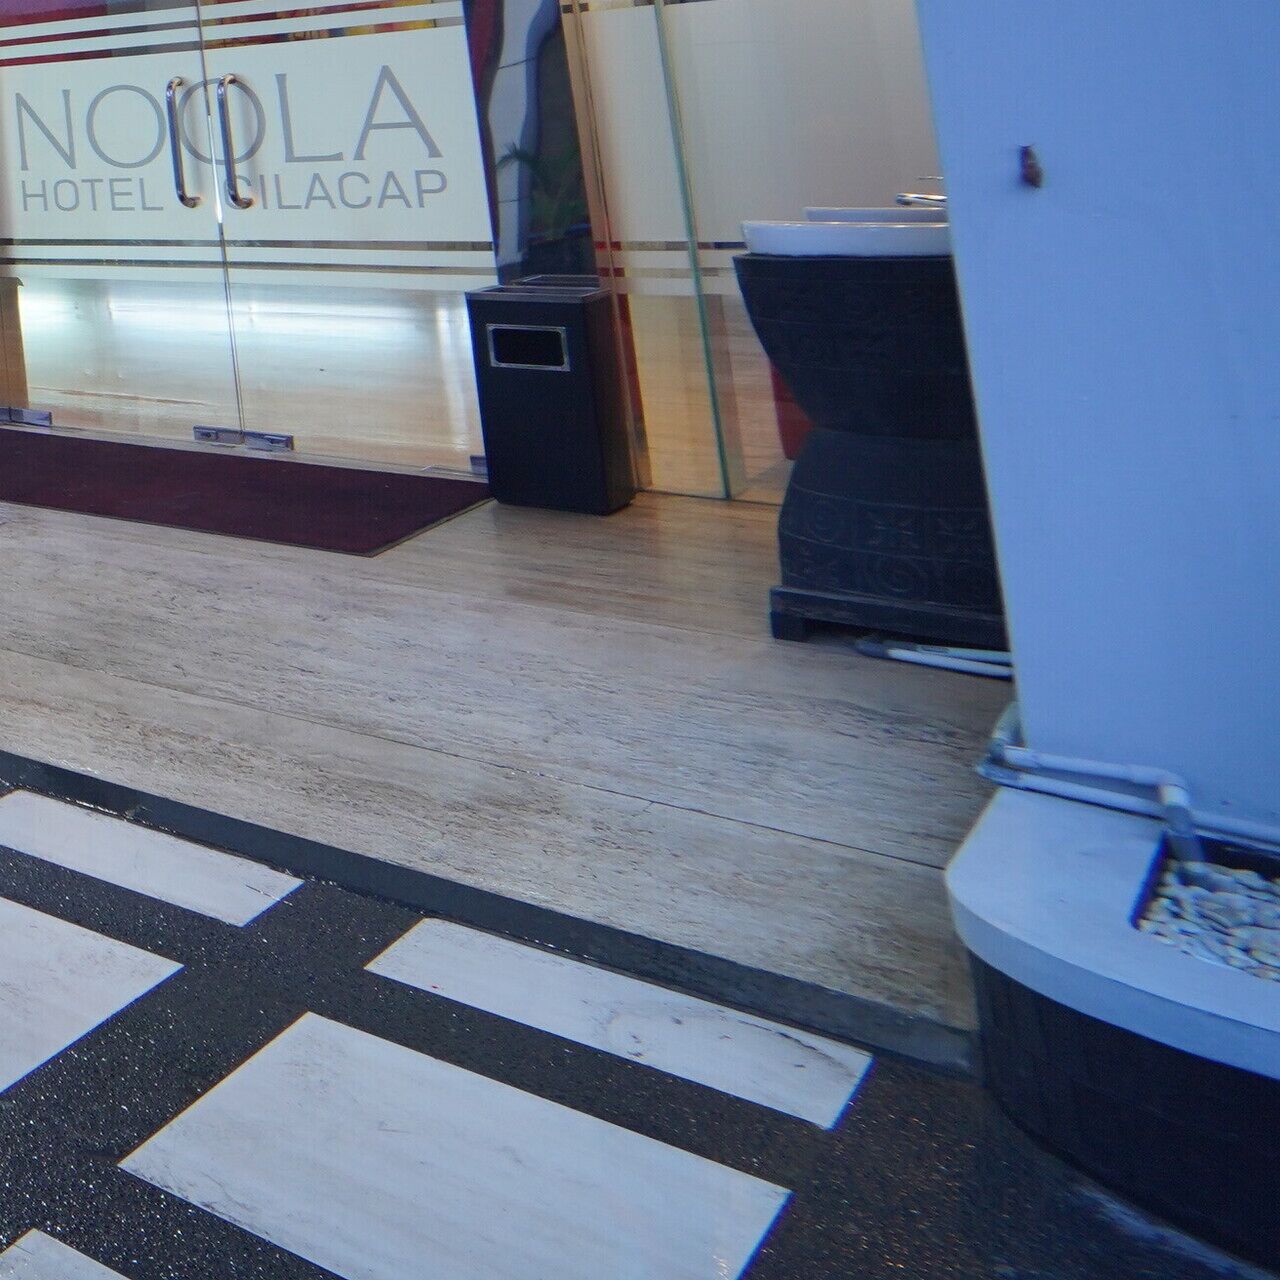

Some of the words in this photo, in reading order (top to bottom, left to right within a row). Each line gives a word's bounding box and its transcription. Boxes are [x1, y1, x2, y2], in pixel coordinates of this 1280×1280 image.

[14, 64, 444, 171] NOOLA
[21, 177, 164, 212] HOTEL
[223, 169, 448, 211] CILACAP
